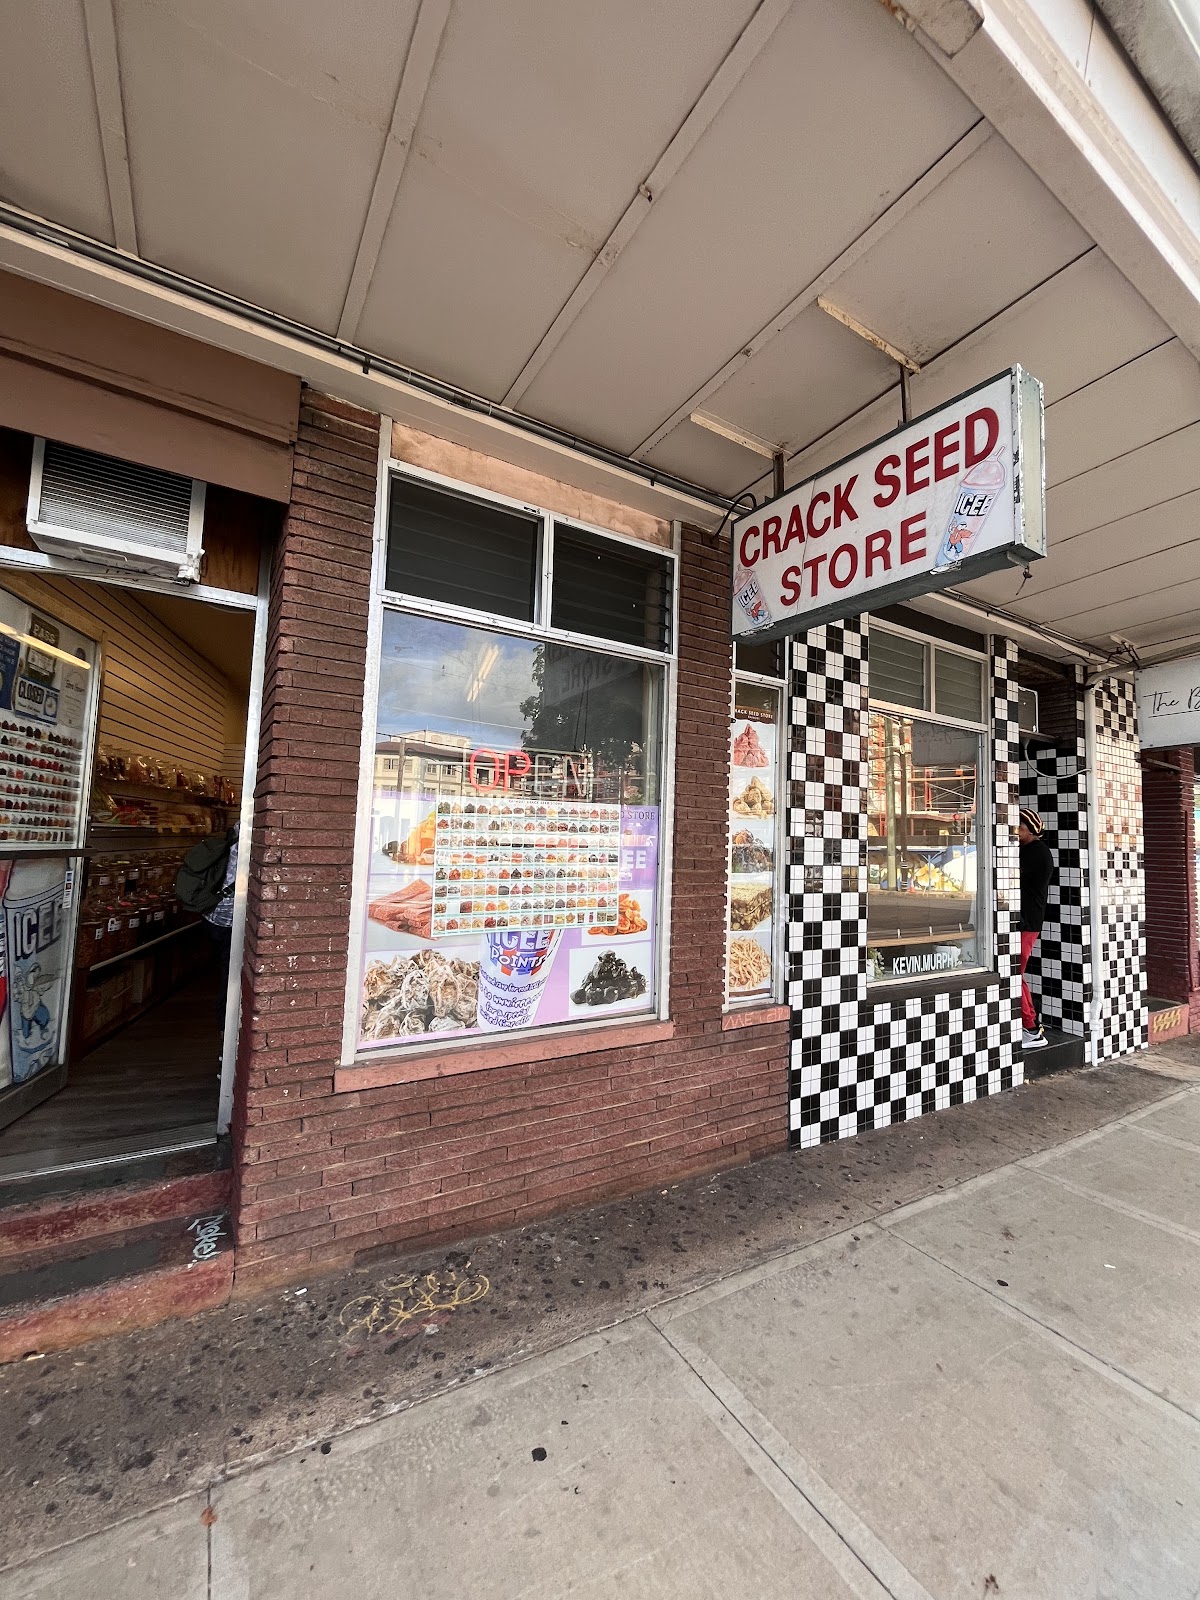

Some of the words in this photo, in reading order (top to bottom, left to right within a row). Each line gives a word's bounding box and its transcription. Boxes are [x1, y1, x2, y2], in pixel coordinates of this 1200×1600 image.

[740, 474, 859, 568] CRACK
[873, 407, 1000, 508] SEED
[954, 492, 995, 517] ICEE
[780, 511, 927, 607] STORE
[738, 581, 760, 608] ICEE
[18, 680, 45, 705] CLOSED
[1143, 691, 1180, 715] The
[469, 747, 589, 797] OPEN
[627, 810, 656, 821] STORE
[14, 897, 65, 960] ICEE
[490, 945, 547, 969] POINTS
